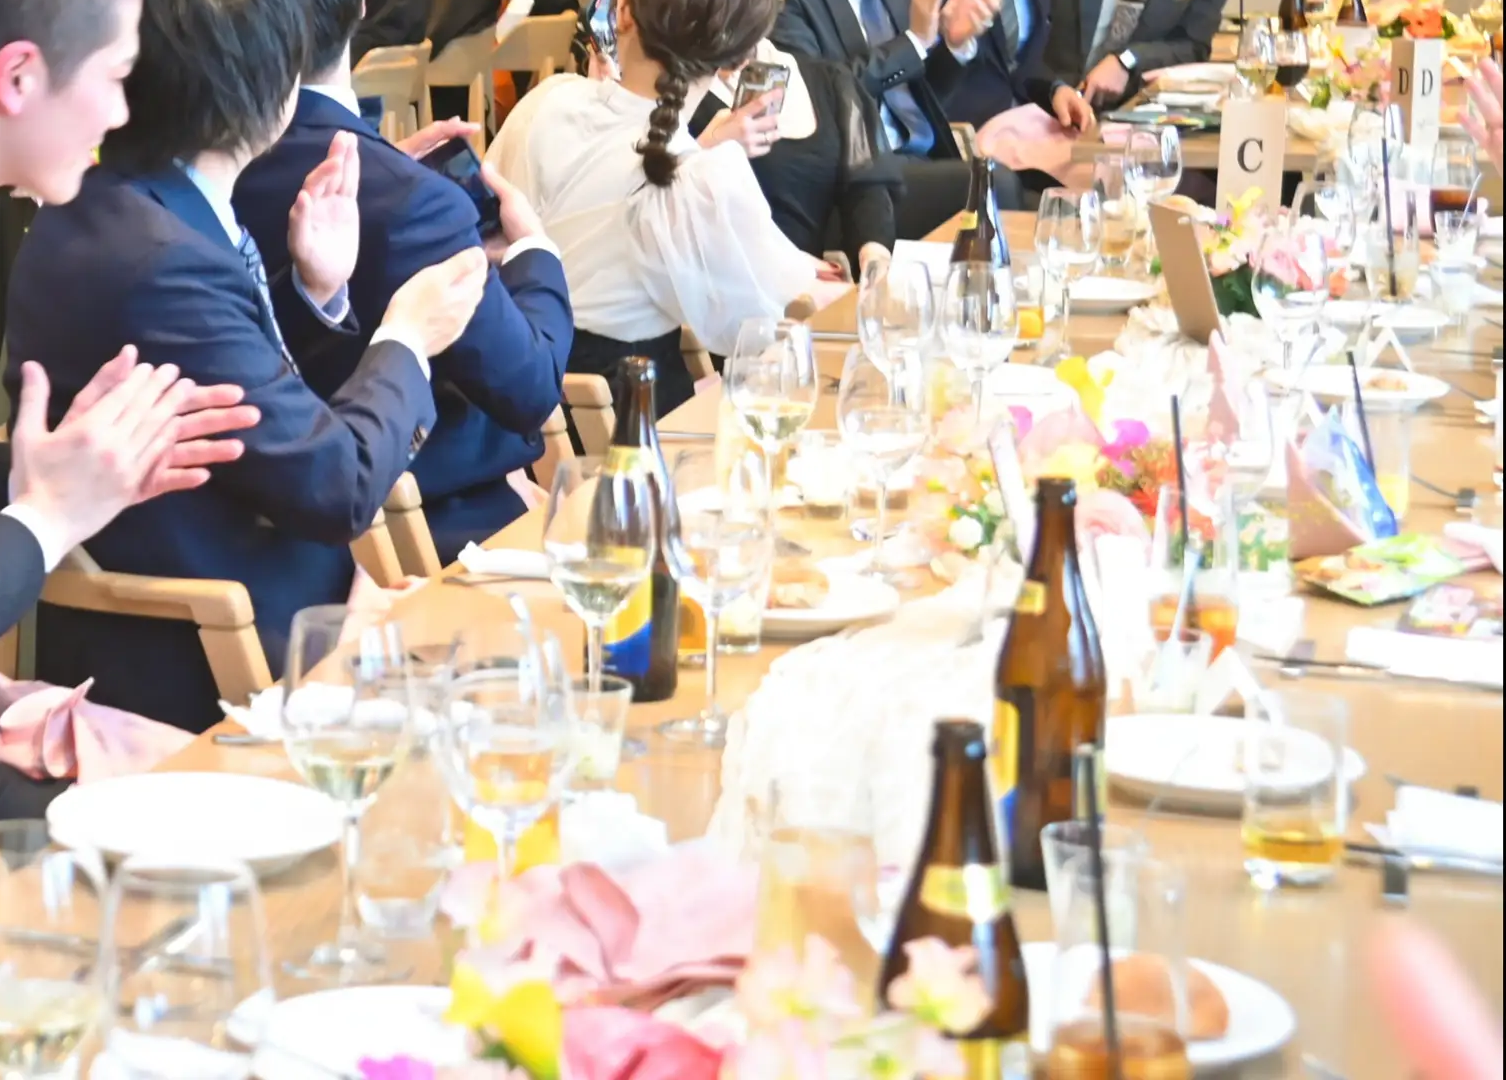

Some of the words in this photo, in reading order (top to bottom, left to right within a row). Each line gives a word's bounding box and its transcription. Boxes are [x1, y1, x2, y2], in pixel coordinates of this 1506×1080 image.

[1398, 67, 1410, 95] D
[1421, 68, 1434, 97] D
[1236, 137, 1264, 173] C
